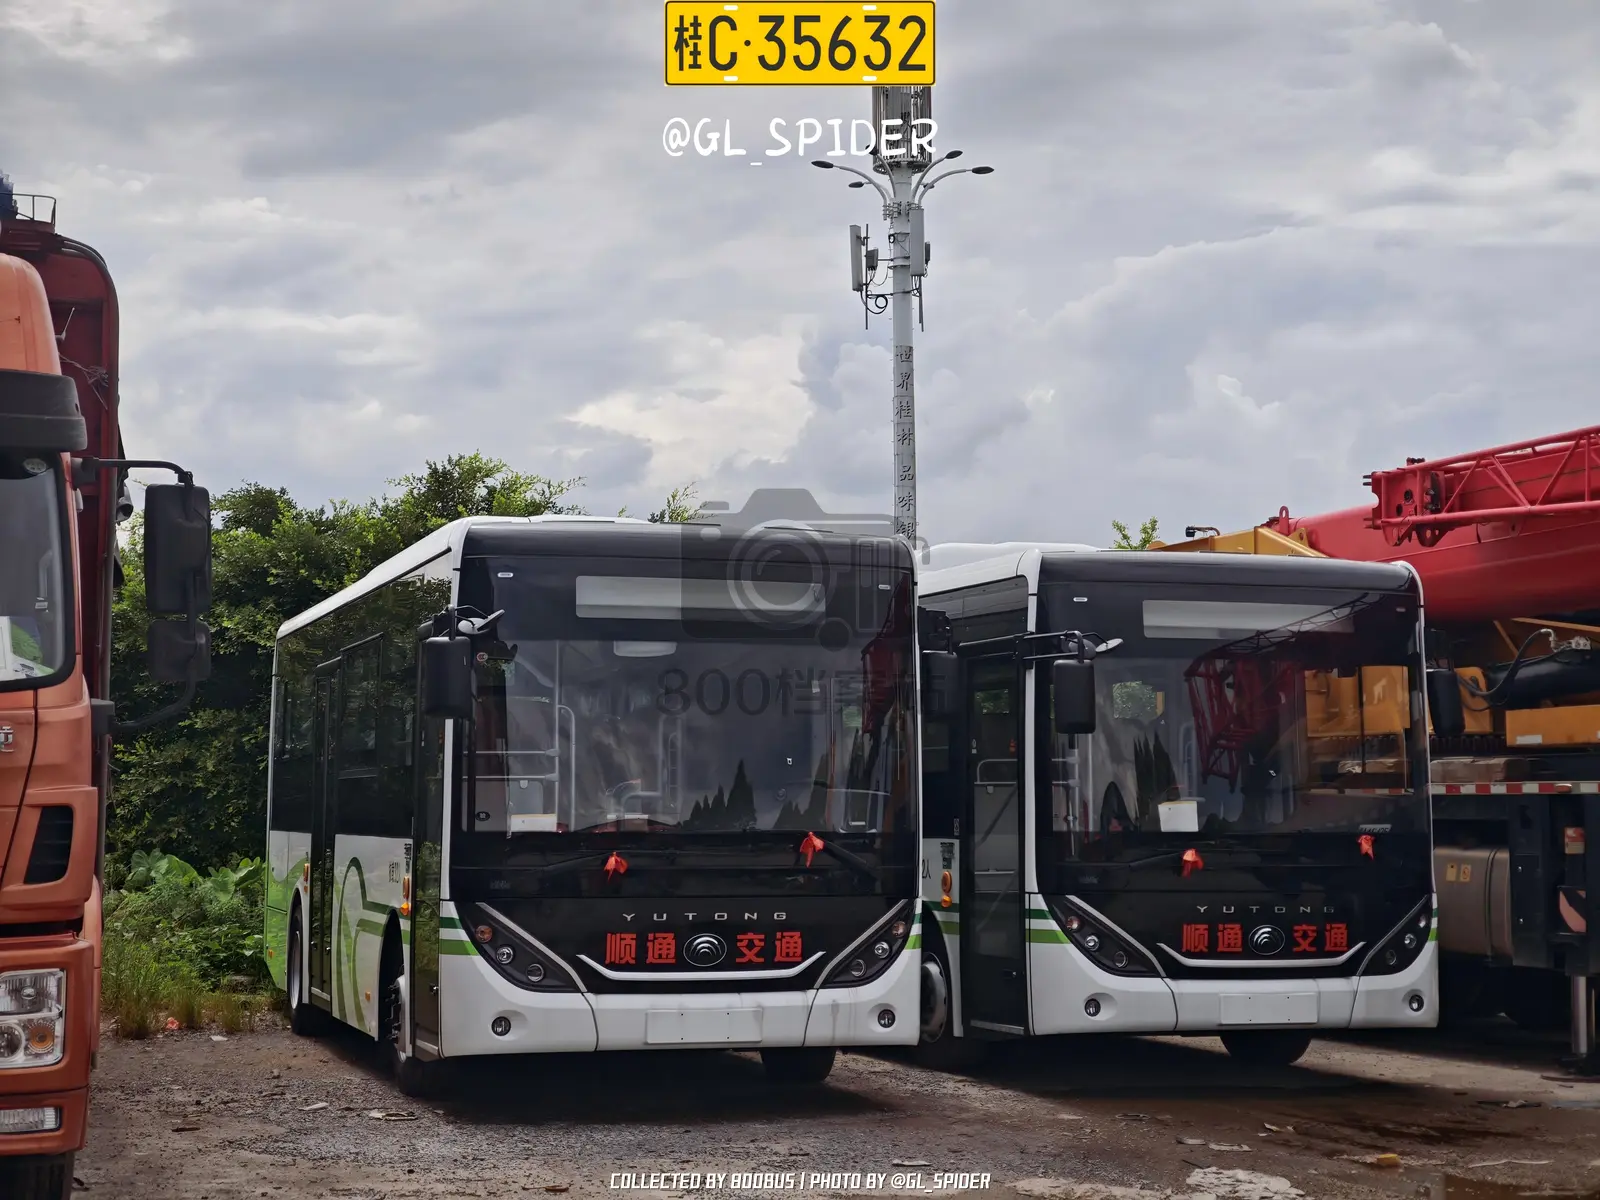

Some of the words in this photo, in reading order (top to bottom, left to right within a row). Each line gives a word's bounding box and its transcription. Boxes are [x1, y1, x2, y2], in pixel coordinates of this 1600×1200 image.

[622, 911, 787, 922] YUTONG
[1196, 904, 1335, 914] YUTONG
[604, 932, 677, 965] 顺通
[735, 931, 804, 964] 交通
[1181, 923, 1244, 953] 顺通
[1292, 922, 1349, 953] 交通
